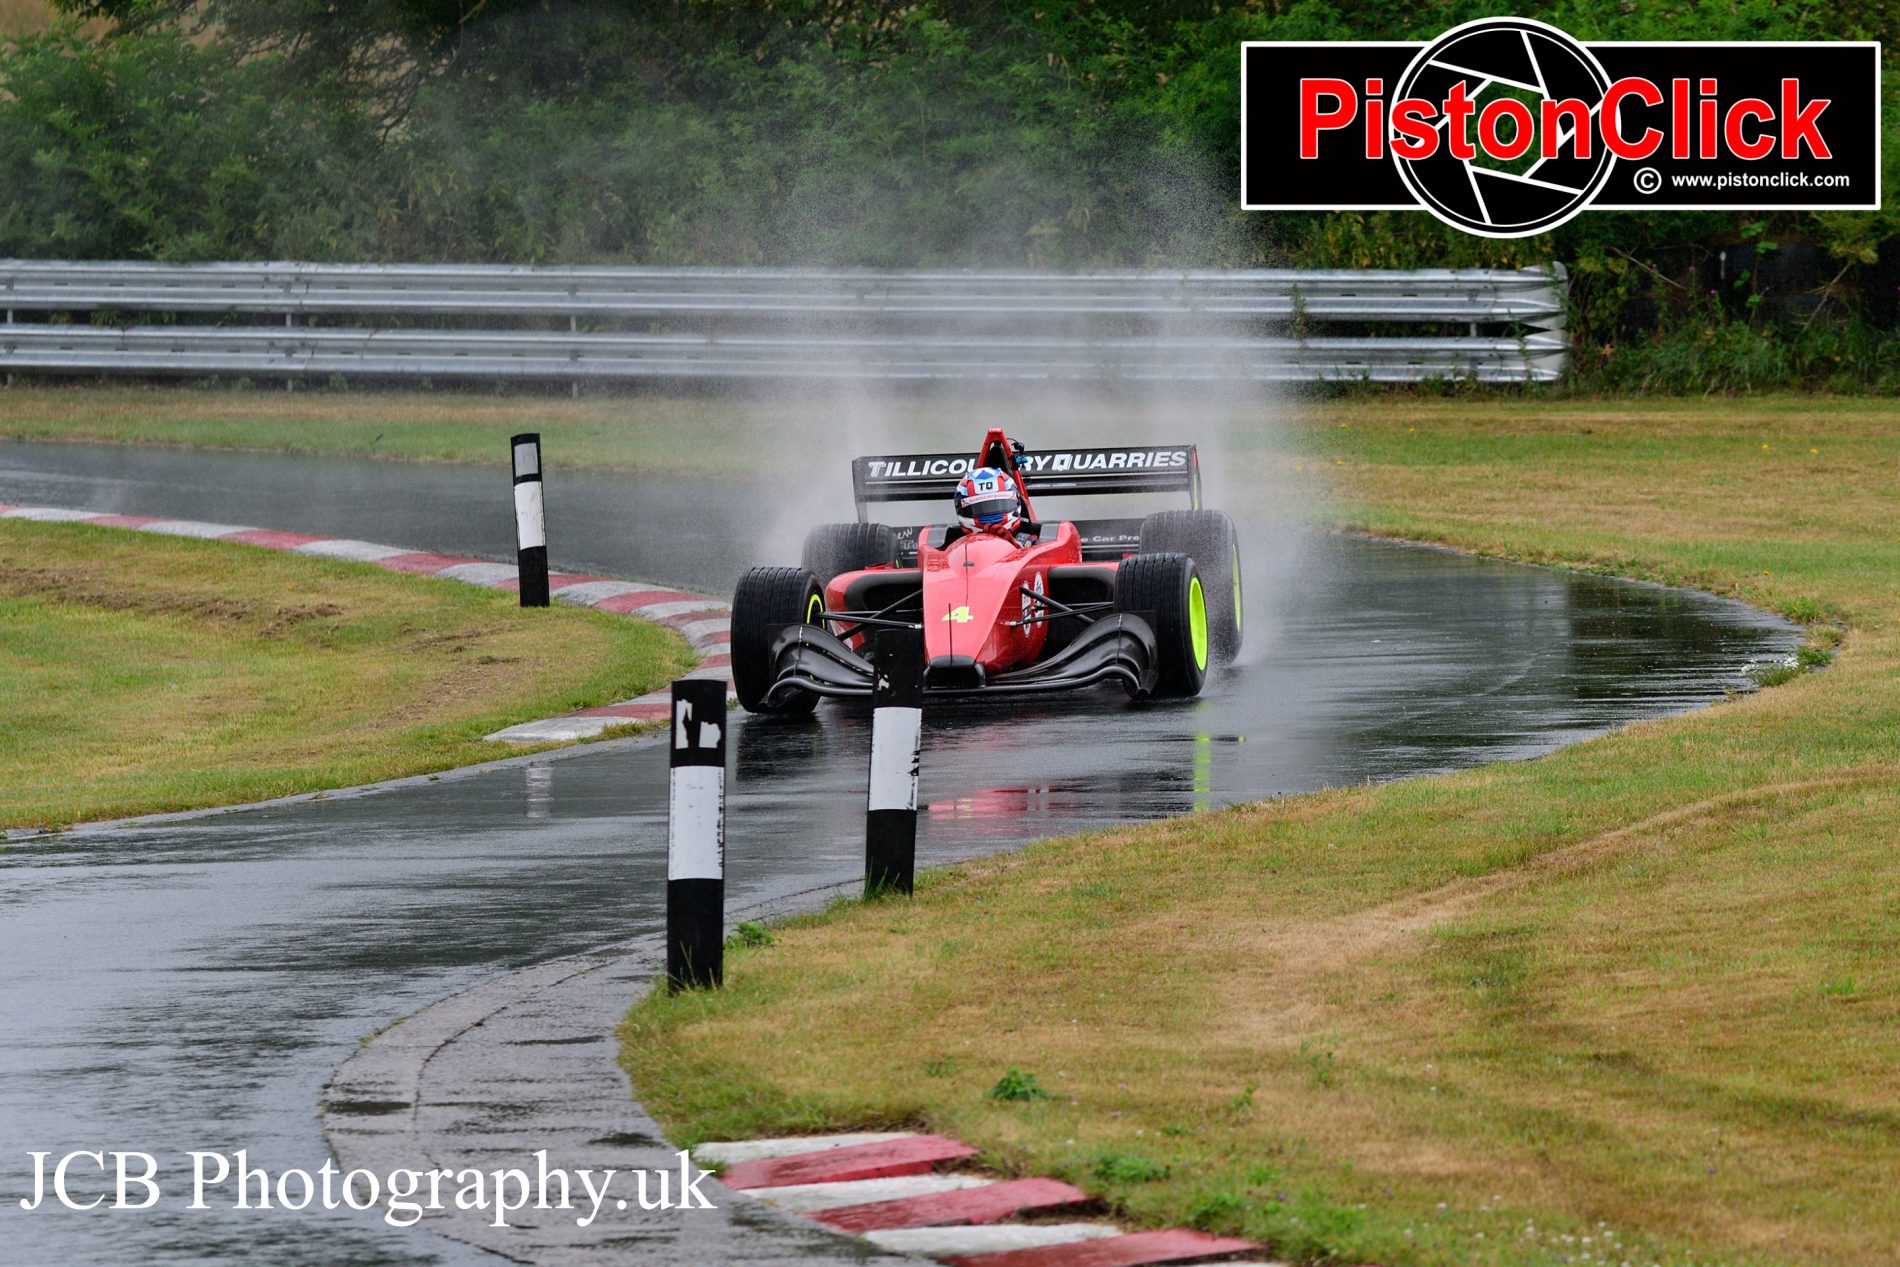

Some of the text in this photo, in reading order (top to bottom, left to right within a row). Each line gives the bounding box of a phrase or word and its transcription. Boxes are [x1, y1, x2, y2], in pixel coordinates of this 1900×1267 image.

[868, 451, 1187, 478] TILLICORY QUARRIES
[941, 606, 974, 623] 4
